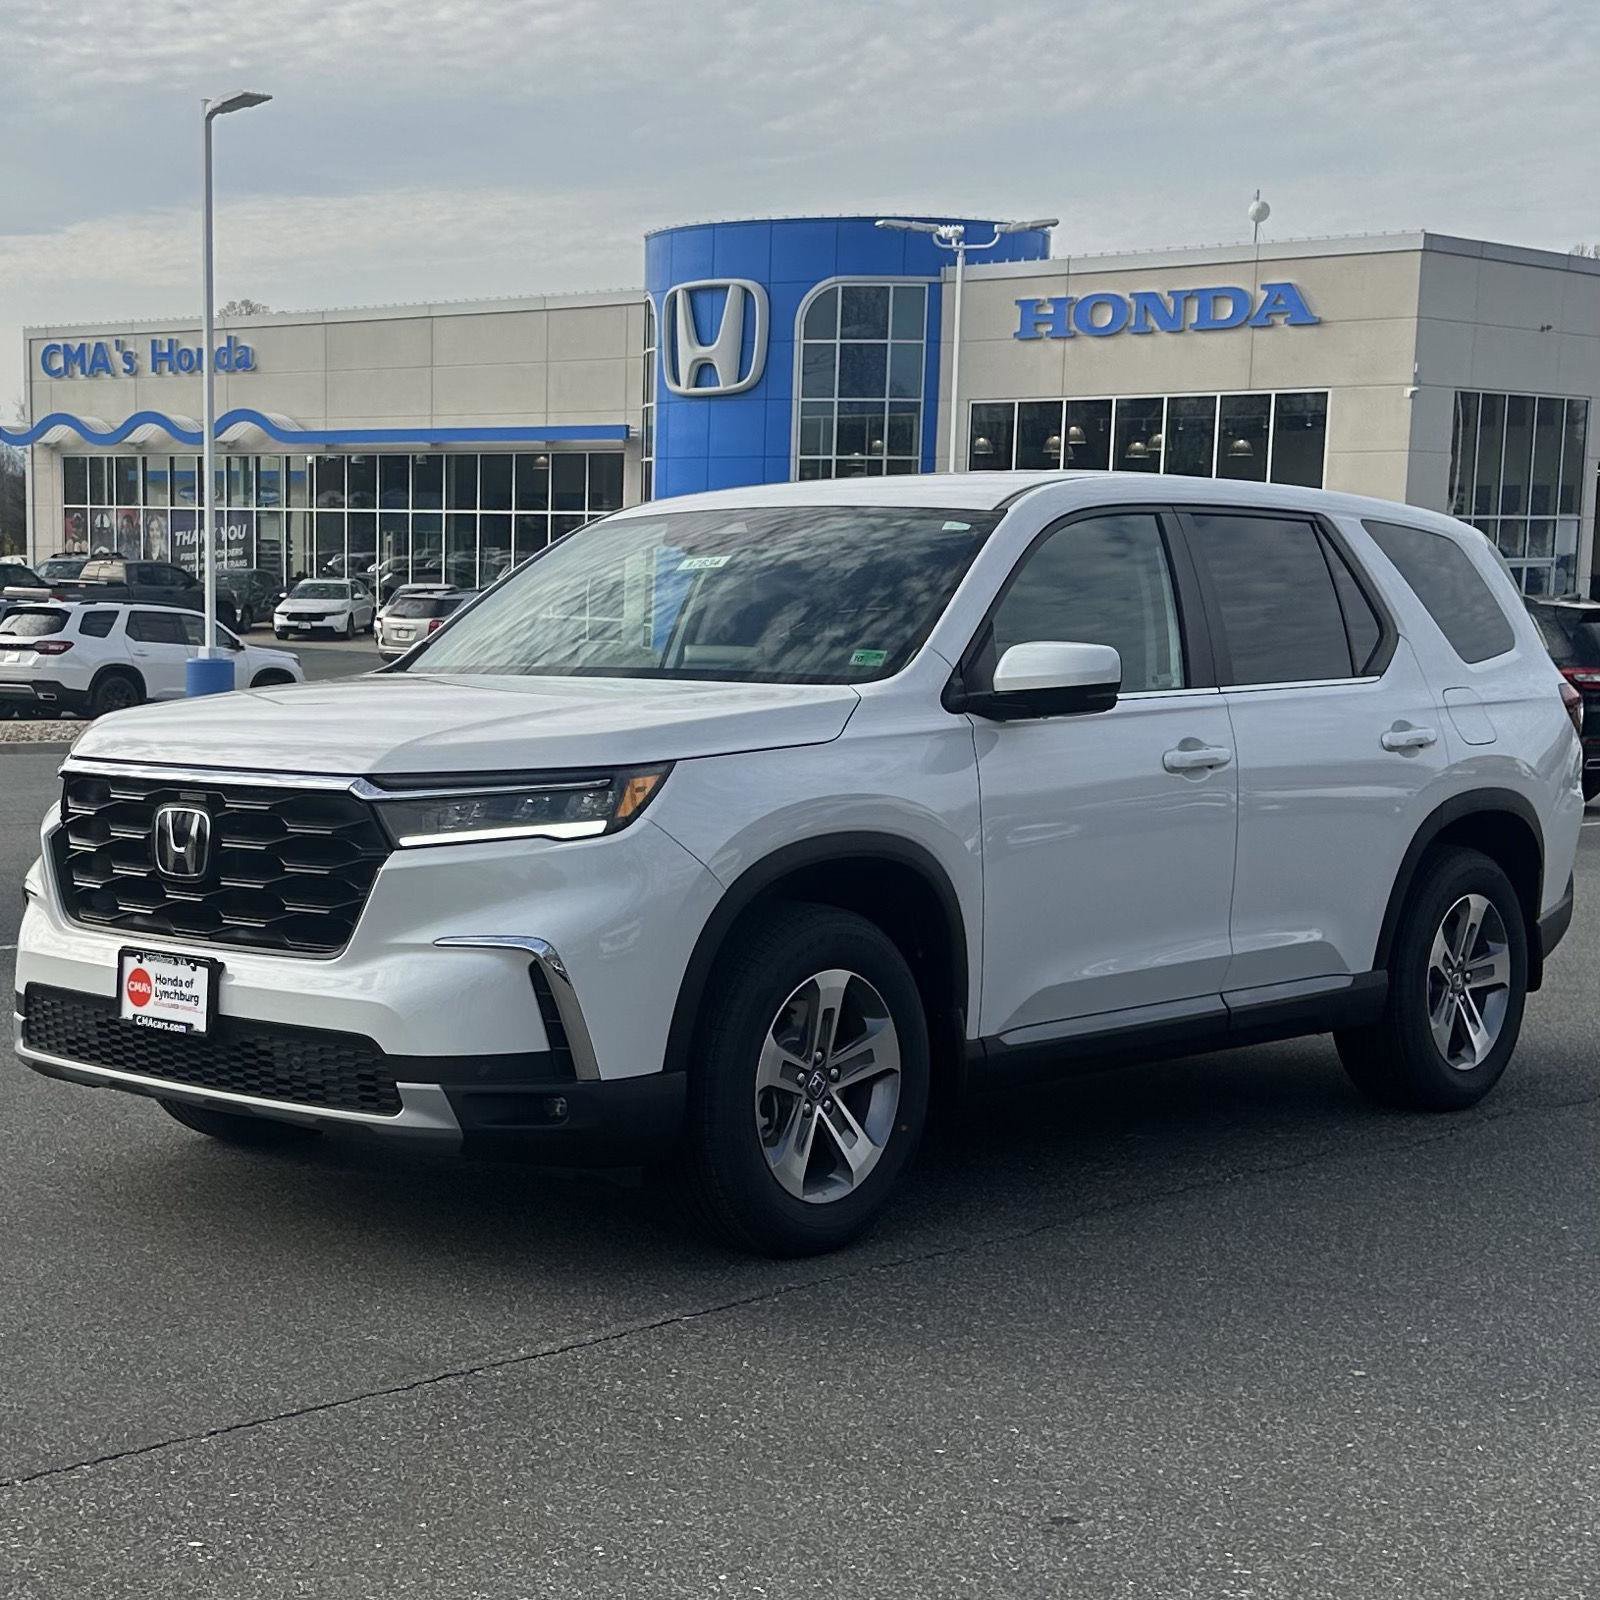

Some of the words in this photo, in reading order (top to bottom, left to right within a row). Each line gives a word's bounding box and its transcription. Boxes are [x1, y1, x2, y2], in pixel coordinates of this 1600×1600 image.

[1013, 282, 1321, 340] HONDA
[41, 339, 139, 379] CMA's
[220, 524, 247, 542] YOU
[155, 973, 183, 988] Honda
[185, 978, 194, 989] of
[155, 987, 200, 1006] Lynchburg
